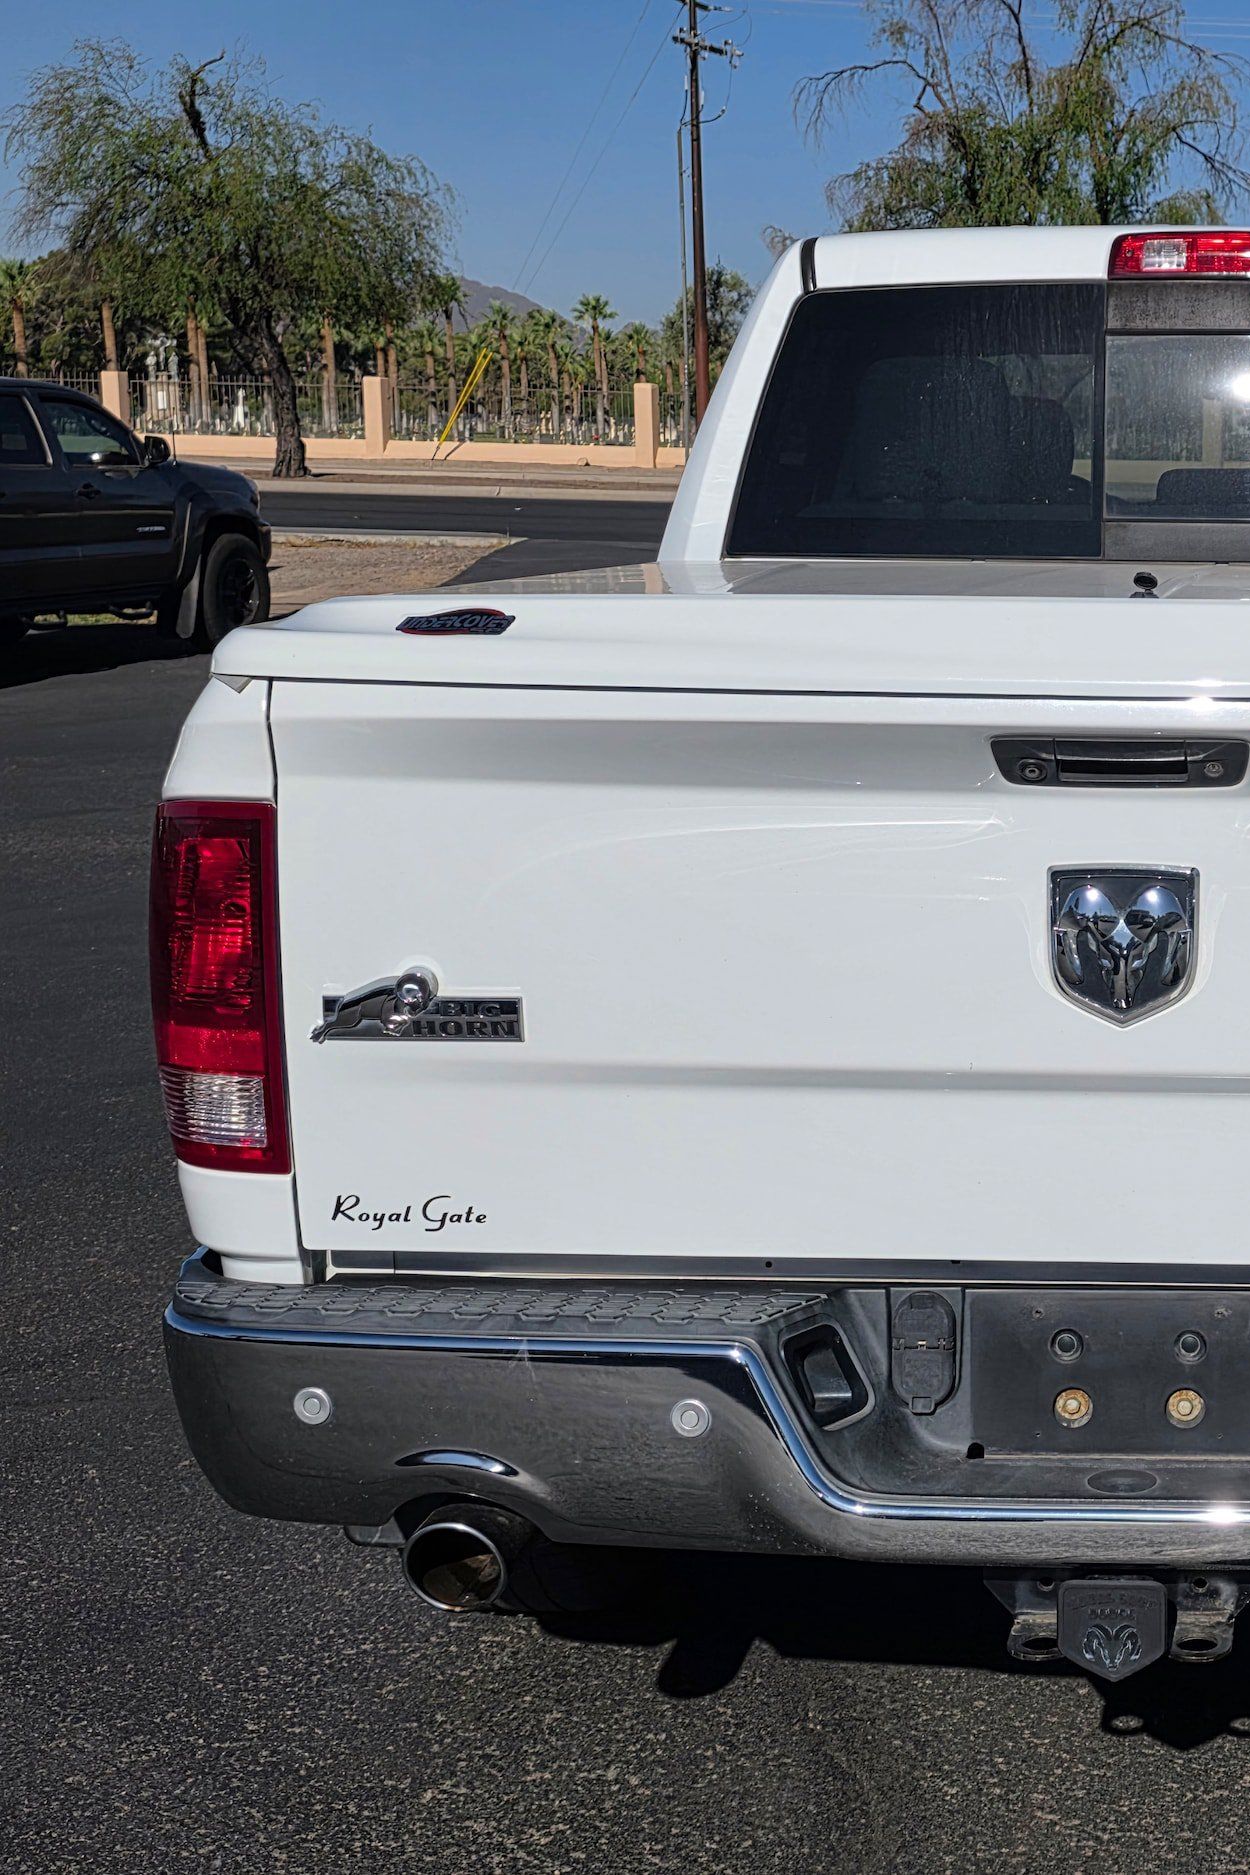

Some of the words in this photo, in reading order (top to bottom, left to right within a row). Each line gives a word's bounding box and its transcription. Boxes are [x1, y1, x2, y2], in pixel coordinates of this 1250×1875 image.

[441, 1001, 501, 1018] BIG
[412, 1020, 517, 1037] HORN
[331, 1194, 412, 1231] Royal
[421, 1195, 487, 1232] Gate
